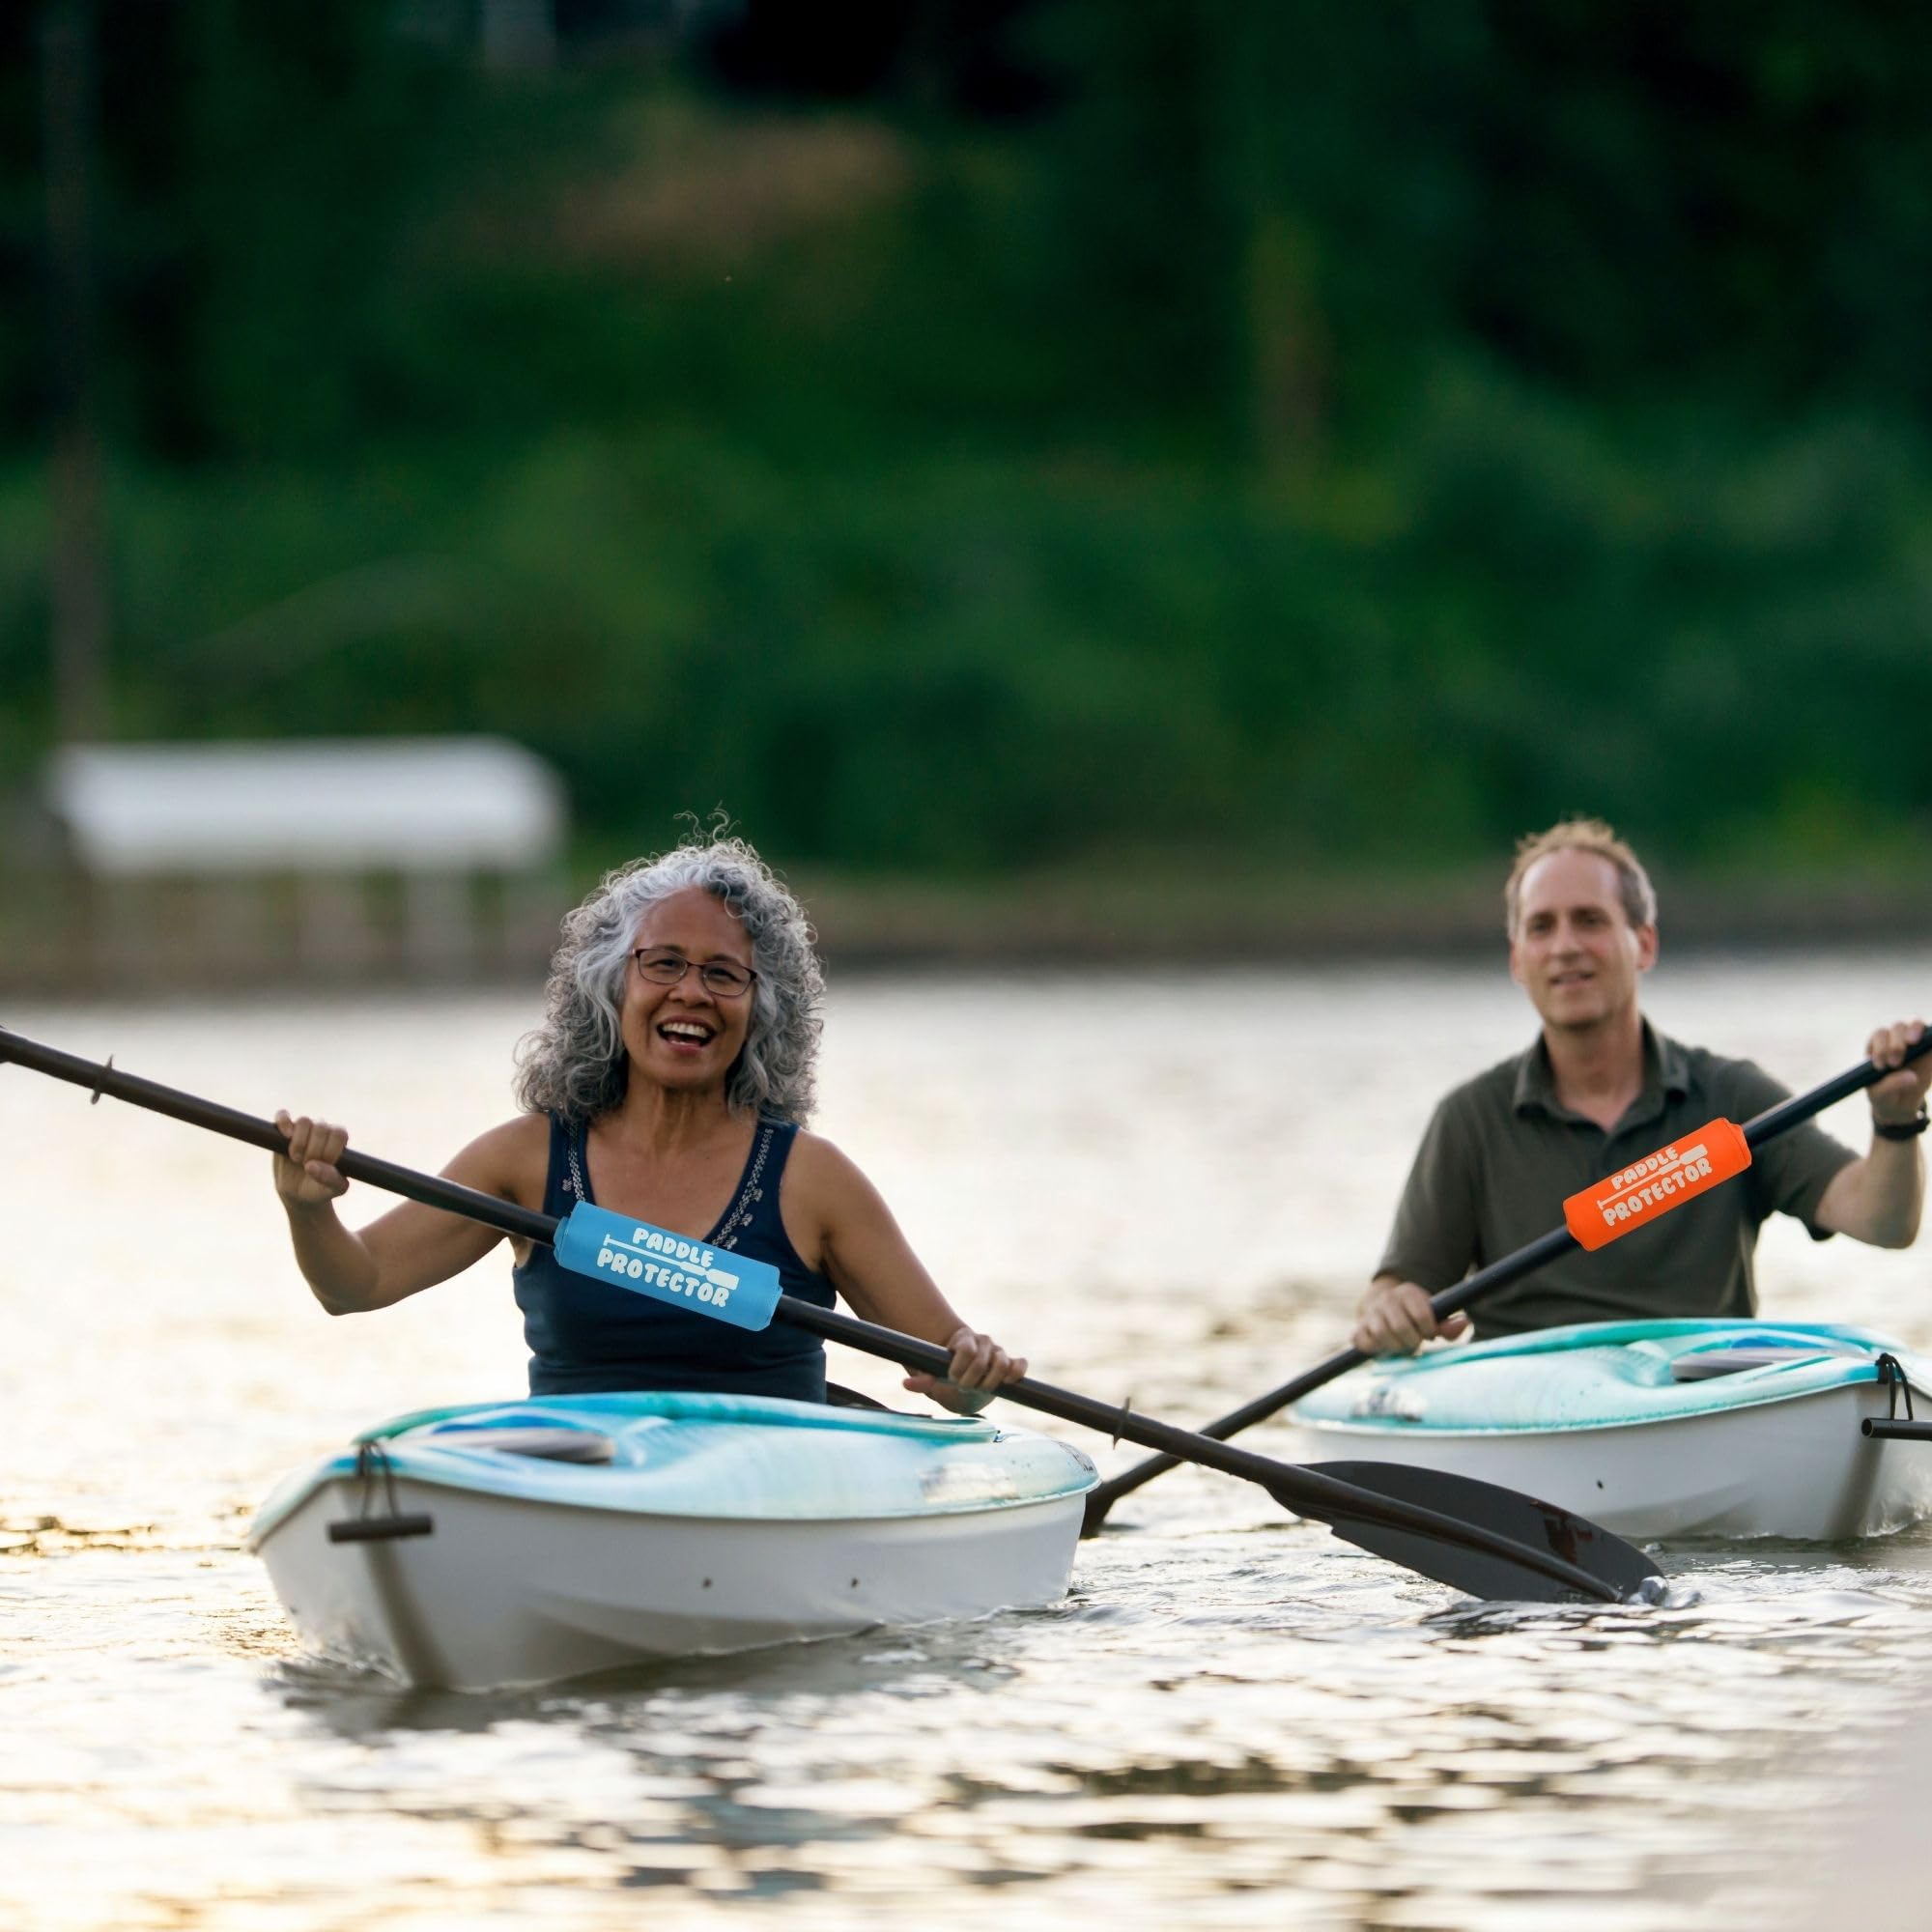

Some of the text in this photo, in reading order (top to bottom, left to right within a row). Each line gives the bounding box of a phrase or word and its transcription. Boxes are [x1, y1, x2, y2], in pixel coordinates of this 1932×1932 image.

[1603, 1158, 1713, 1227] PROTECTOR
[1611, 1147, 1679, 1190] PADDLE
[633, 1227, 714, 1267] PADDLE
[597, 1248, 729, 1307] PROTECTOR
